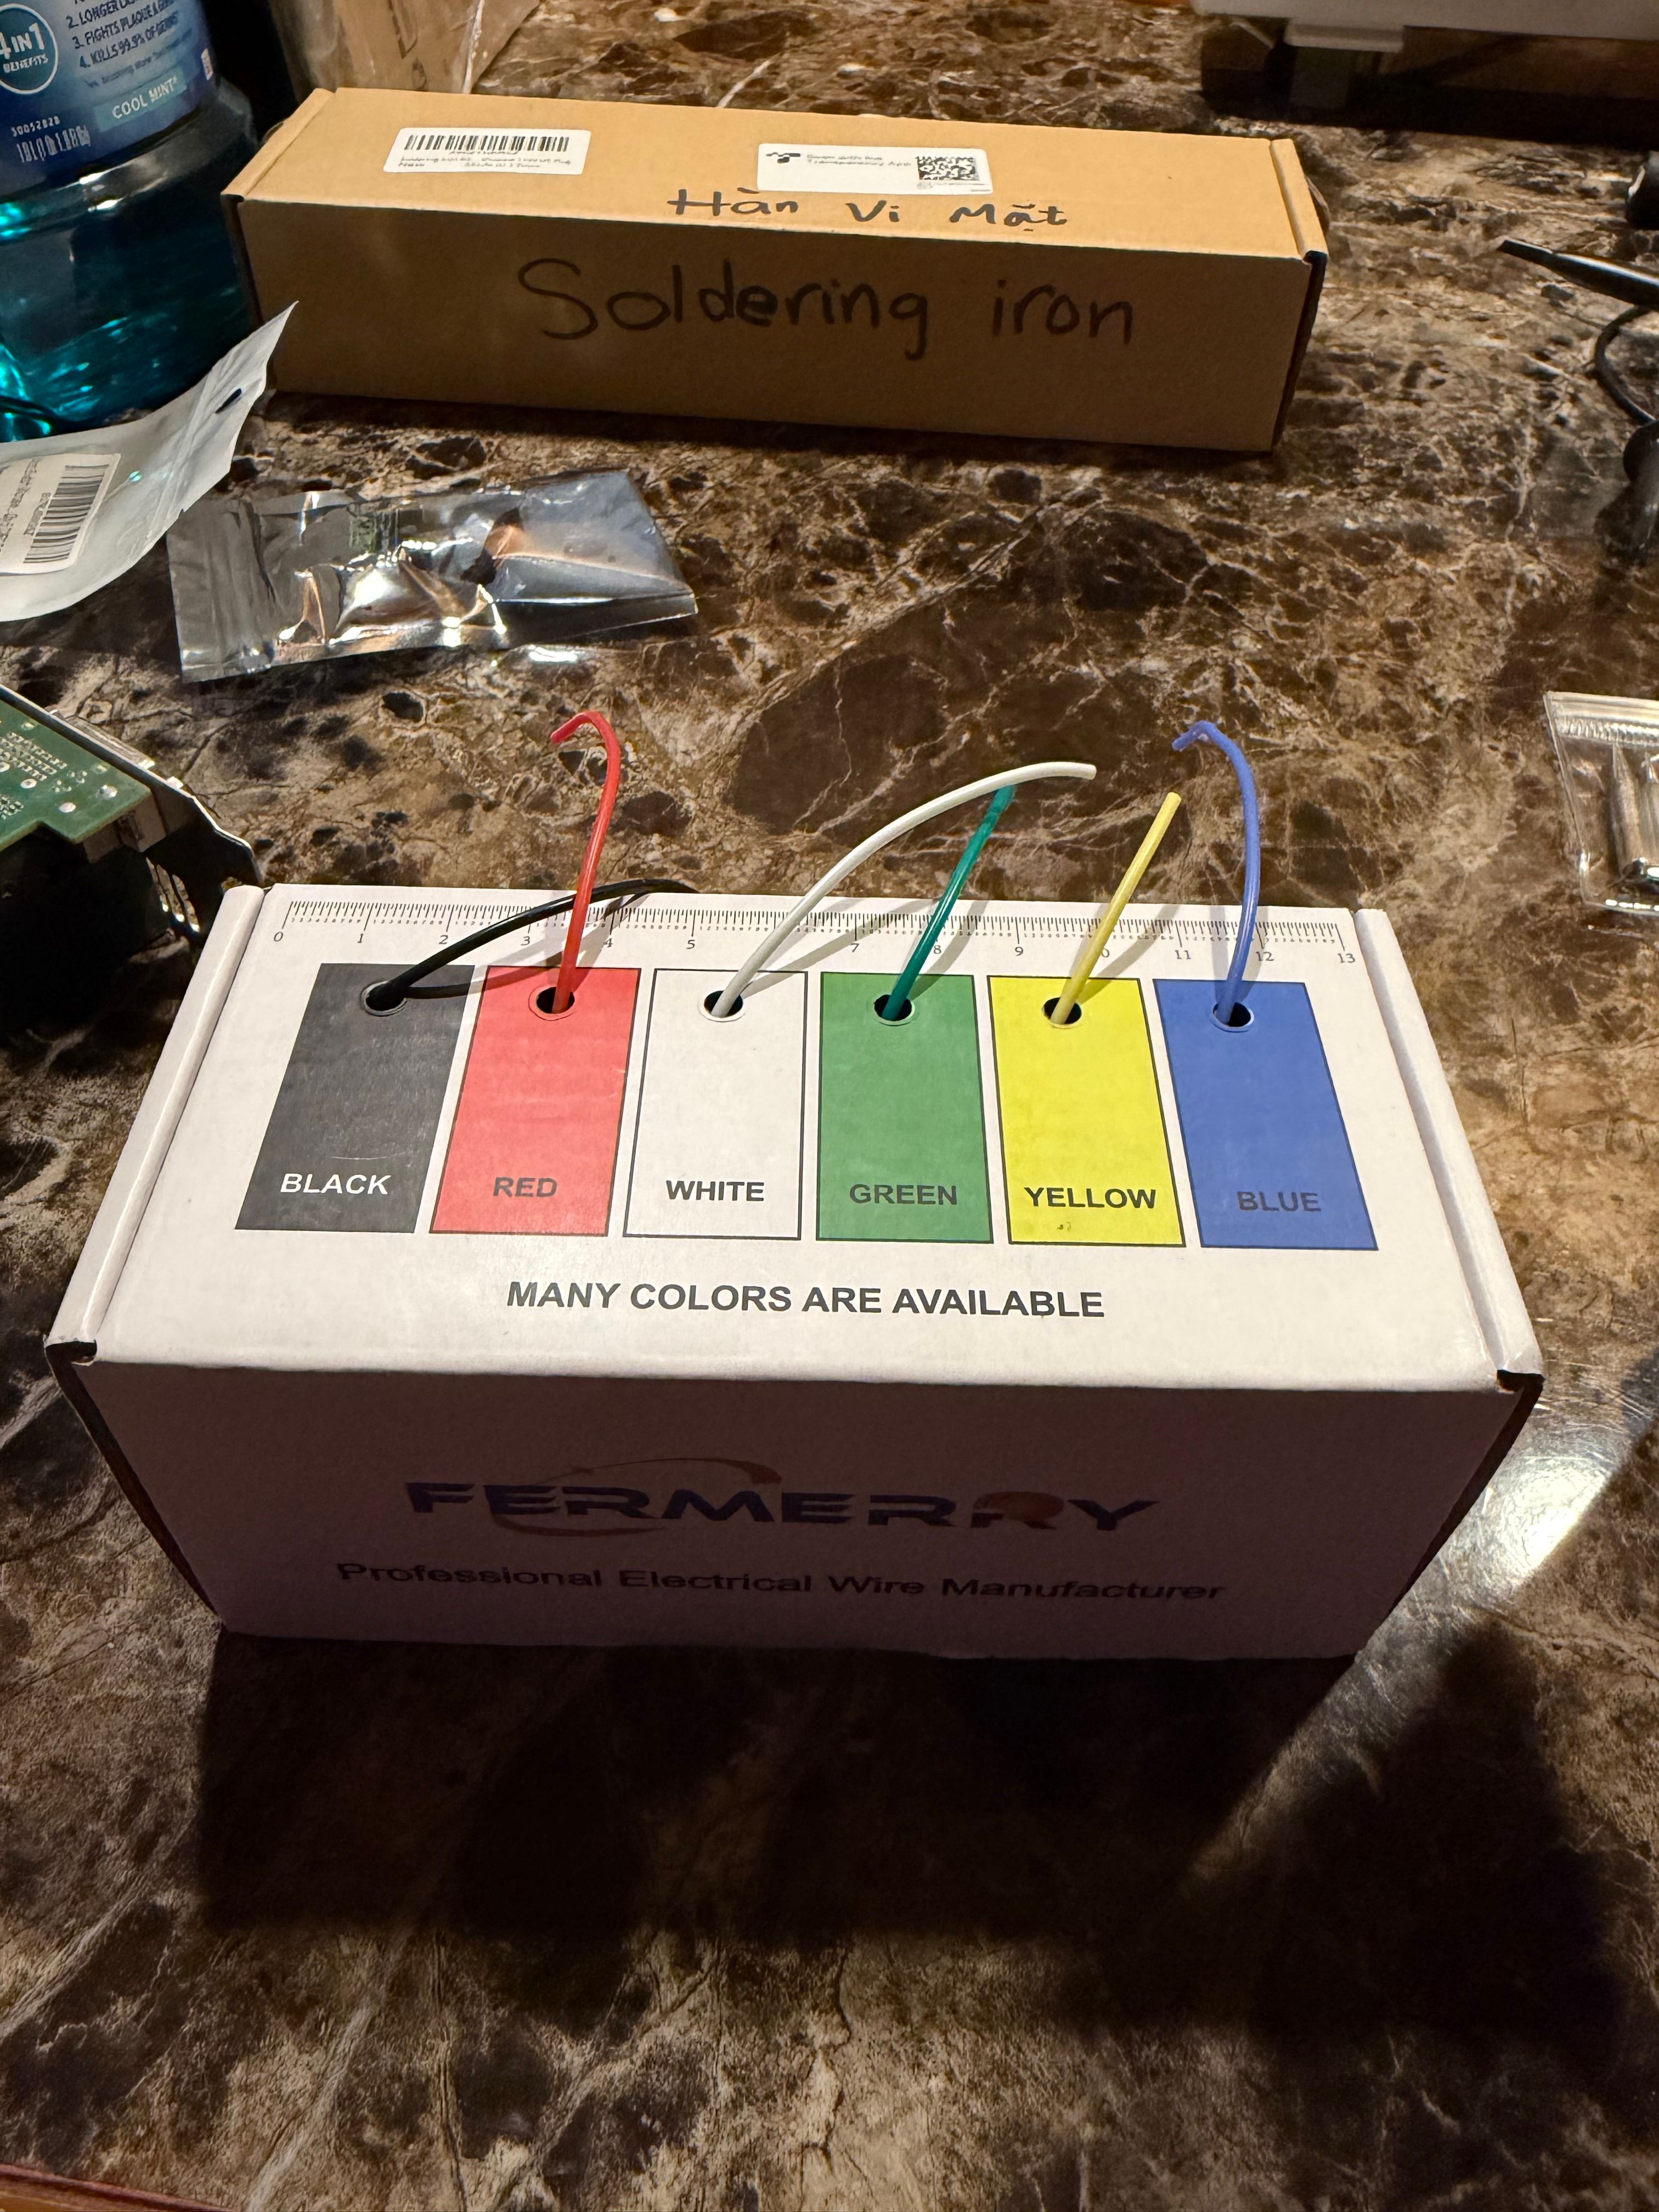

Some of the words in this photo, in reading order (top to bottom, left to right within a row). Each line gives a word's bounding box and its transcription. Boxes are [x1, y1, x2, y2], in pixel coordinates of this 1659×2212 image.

[11, 32, 32, 53] IN
[29, 22, 44, 50] 1
[84, 21, 120, 45] FIGHTS
[112, 94, 148, 119] COOL
[845, 200, 900, 222] Vi
[517, 257, 928, 361] Soldering
[992, 279, 1135, 345] iron
[274, 932, 284, 942] 0
[357, 933, 364, 944] 1
[439, 935, 448, 944] 2
[521, 936, 531, 946] 3
[604, 938, 613, 948] 4
[686, 940, 695, 949] 5
[850, 943, 860, 953] 7
[934, 945, 942, 955] 8
[1015, 946, 1024, 956] 9
[1175, 950, 1191, 960] 11
[1255, 951, 1274, 962] 12
[1337, 953, 1356, 963] 13
[280, 1173, 392, 1195] BLACK
[493, 1176, 558, 1198] RED
[665, 1180, 765, 1202] WHITE
[849, 1183, 958, 1205] GREEN
[1024, 1186, 1156, 1209] YELLOW
[1237, 1190, 1321, 1212] BLUE
[507, 1282, 621, 1308] MANY
[630, 1283, 791, 1313] COLORS
[802, 1286, 881, 1313] ARE
[891, 1288, 1105, 1317] AVAILABLE
[405, 1482, 1161, 1531] FERMERRY
[336, 1562, 602, 1587] Professional
[619, 1569, 811, 1593] Electrical
[827, 1576, 925, 1595] Wire
[941, 1578, 1228, 1600] Manufacturer
